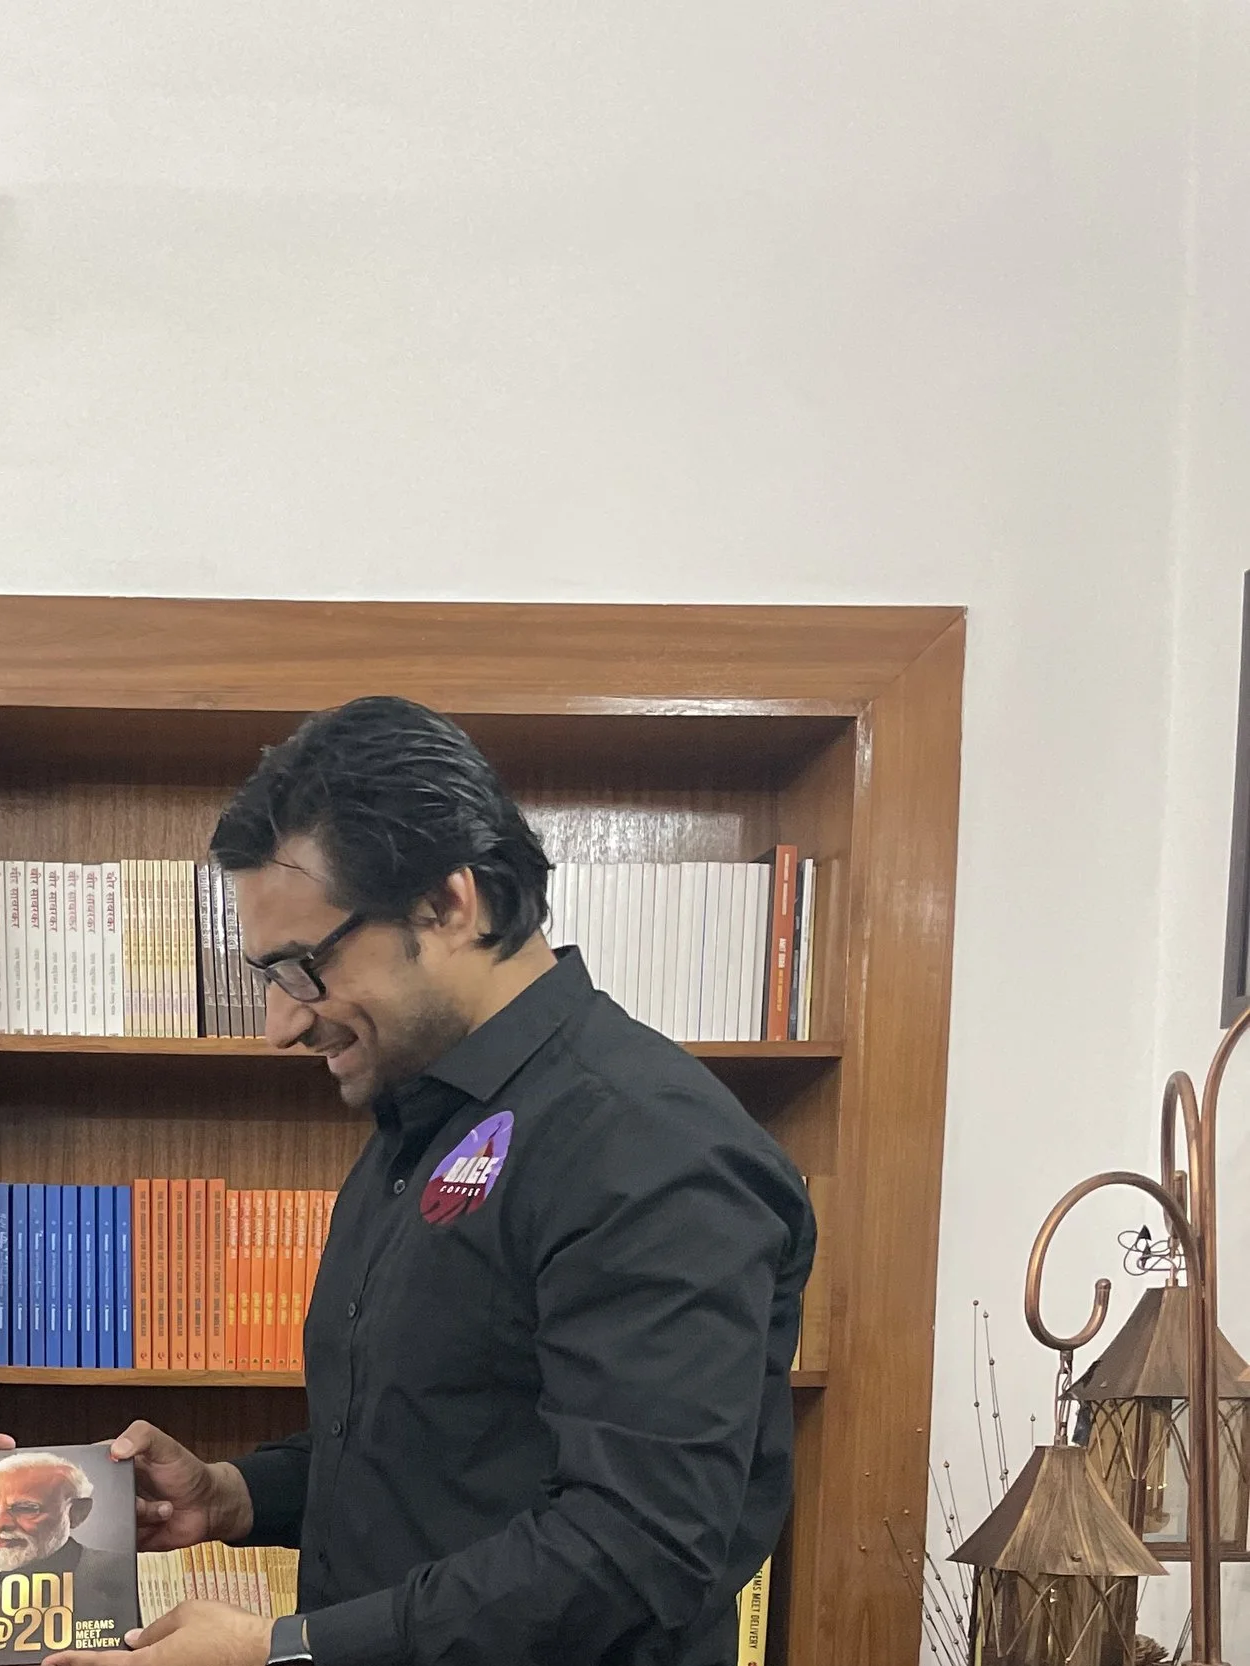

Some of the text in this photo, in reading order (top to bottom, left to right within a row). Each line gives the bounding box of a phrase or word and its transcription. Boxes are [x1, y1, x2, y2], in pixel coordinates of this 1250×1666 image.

[106, 892, 116, 933] सावरकर
[76, 1620, 115, 1630] DREAMS
[76, 1629, 101, 1639] MEET
[76, 1638, 121, 1649] DELIVERY
